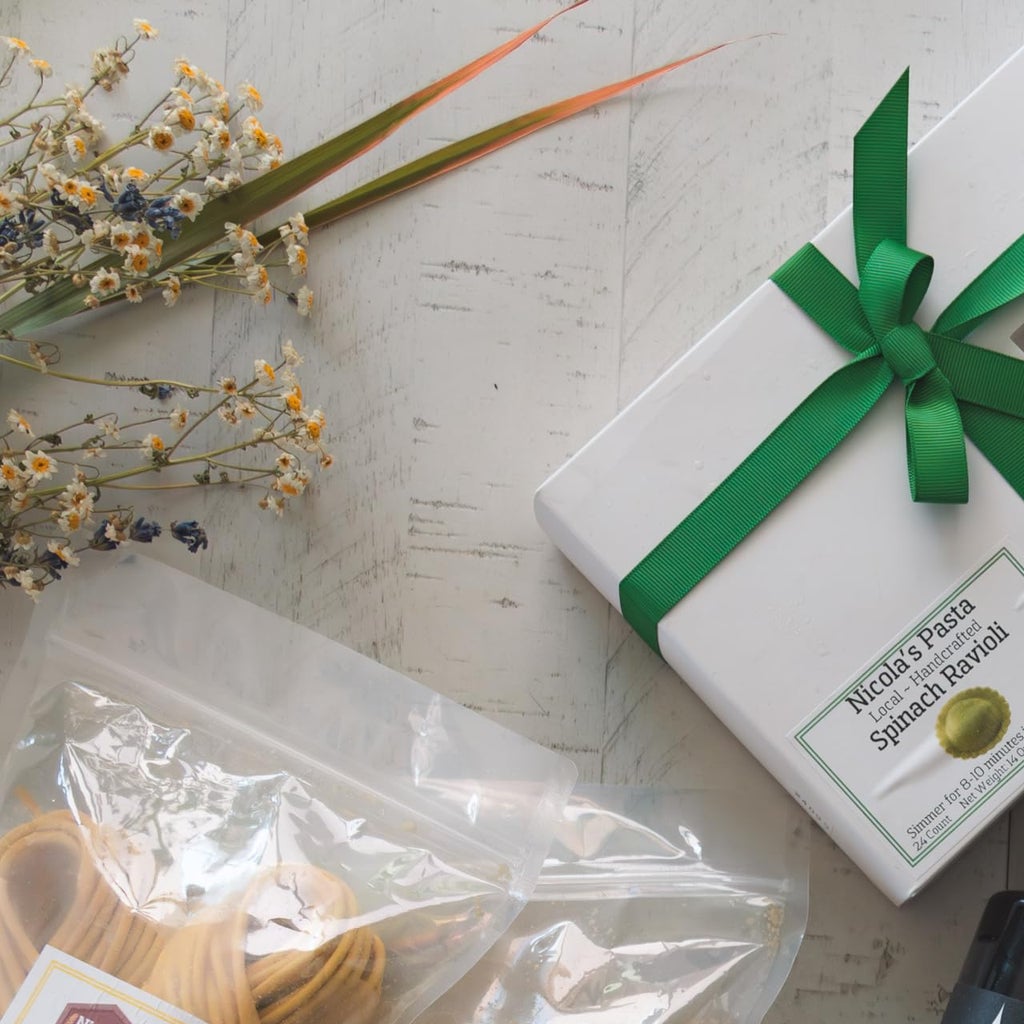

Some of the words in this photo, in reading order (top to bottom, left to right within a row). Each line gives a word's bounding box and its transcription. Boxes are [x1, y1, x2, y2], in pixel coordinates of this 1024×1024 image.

[845, 645, 922, 715] Nicola's
[917, 598, 977, 650] Pasta
[868, 689, 904, 723] Local
[909, 618, 982, 687] Handcrafted
[870, 683, 947, 751] Spinach
[939, 621, 1010, 687] Ravioli
[906, 802, 945, 839] Simmer
[944, 788, 961, 805] for
[959, 766, 985, 791] 8-10
[983, 732, 1024, 770] minutes
[912, 836, 928, 852] 24
[925, 815, 952, 839] Count
[959, 792, 977, 809] Net
[1006, 754, 1019, 767] 14
